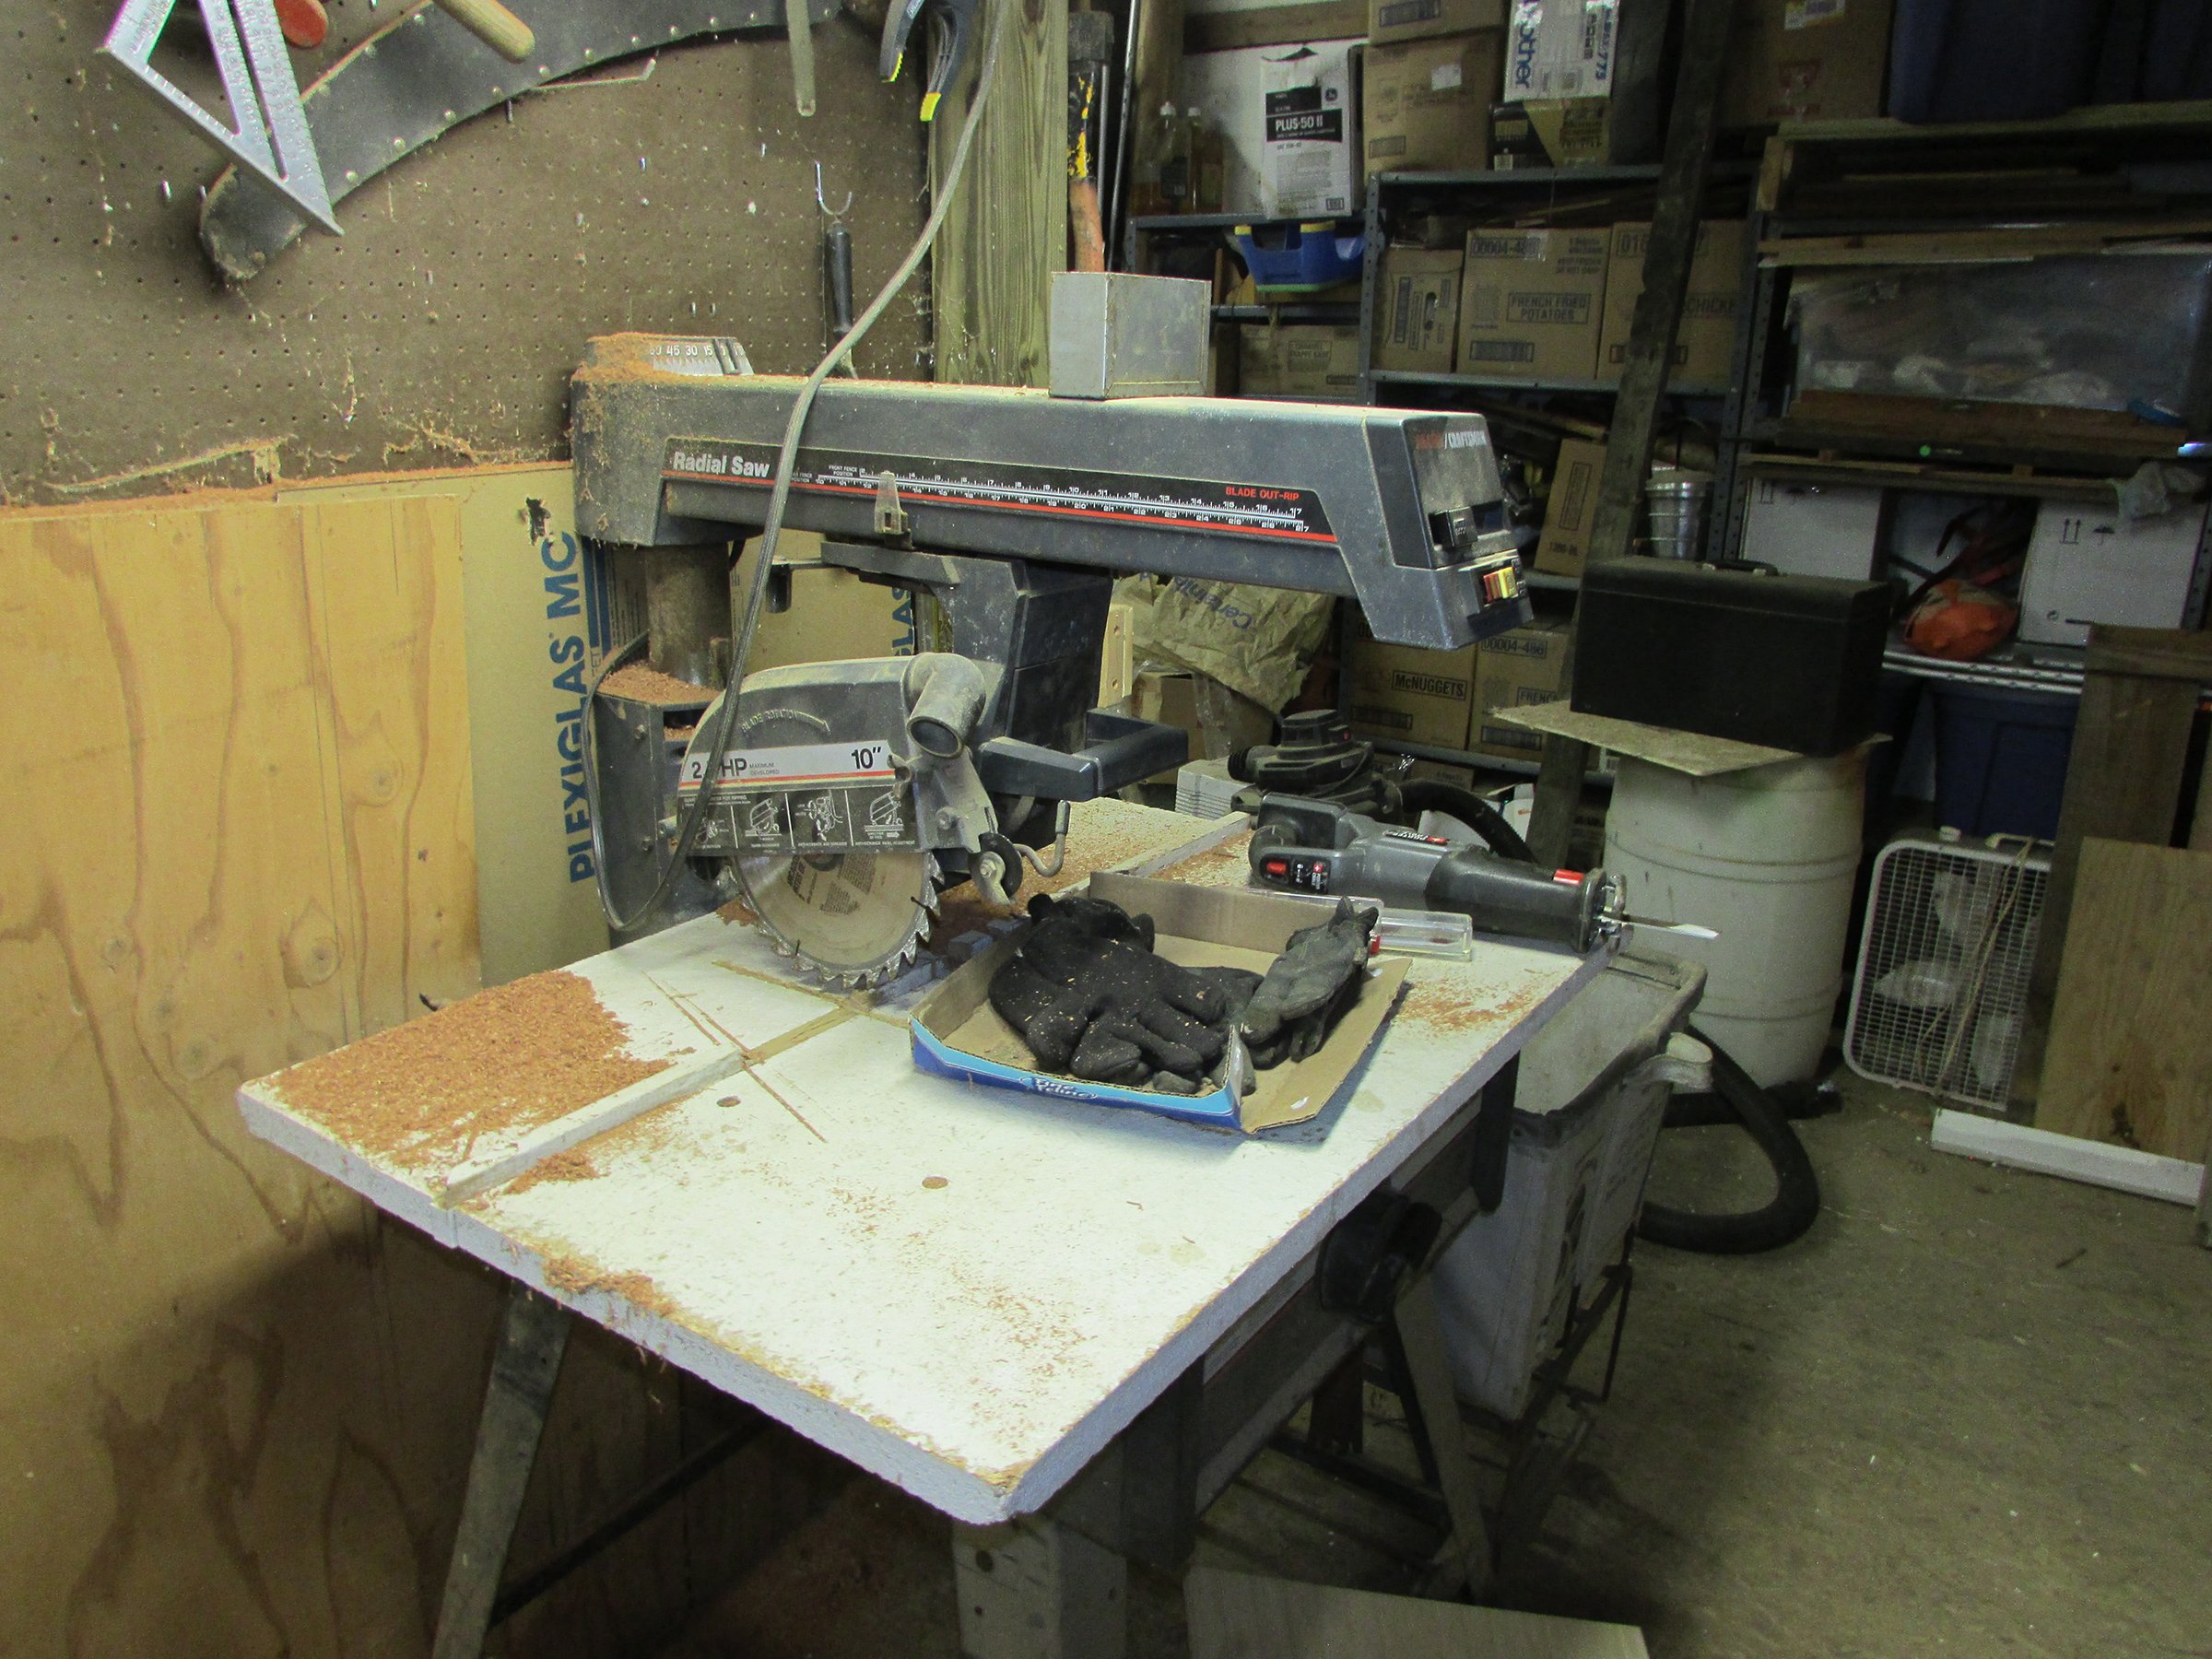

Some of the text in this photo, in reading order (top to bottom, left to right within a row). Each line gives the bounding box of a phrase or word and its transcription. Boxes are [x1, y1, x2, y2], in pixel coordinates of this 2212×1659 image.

[685, 345, 698, 357] 30
[703, 345, 713, 356] 15
[673, 451, 771, 477] Radial Saw
[1226, 486, 1300, 500] BLADE OUT-RIP
[540, 531, 582, 620] MC
[1394, 674, 1465, 698] McNUGGETS
[721, 758, 747, 778] HP
[851, 746, 883, 770] 10"
[749, 768, 781, 776] DEVELOPED
